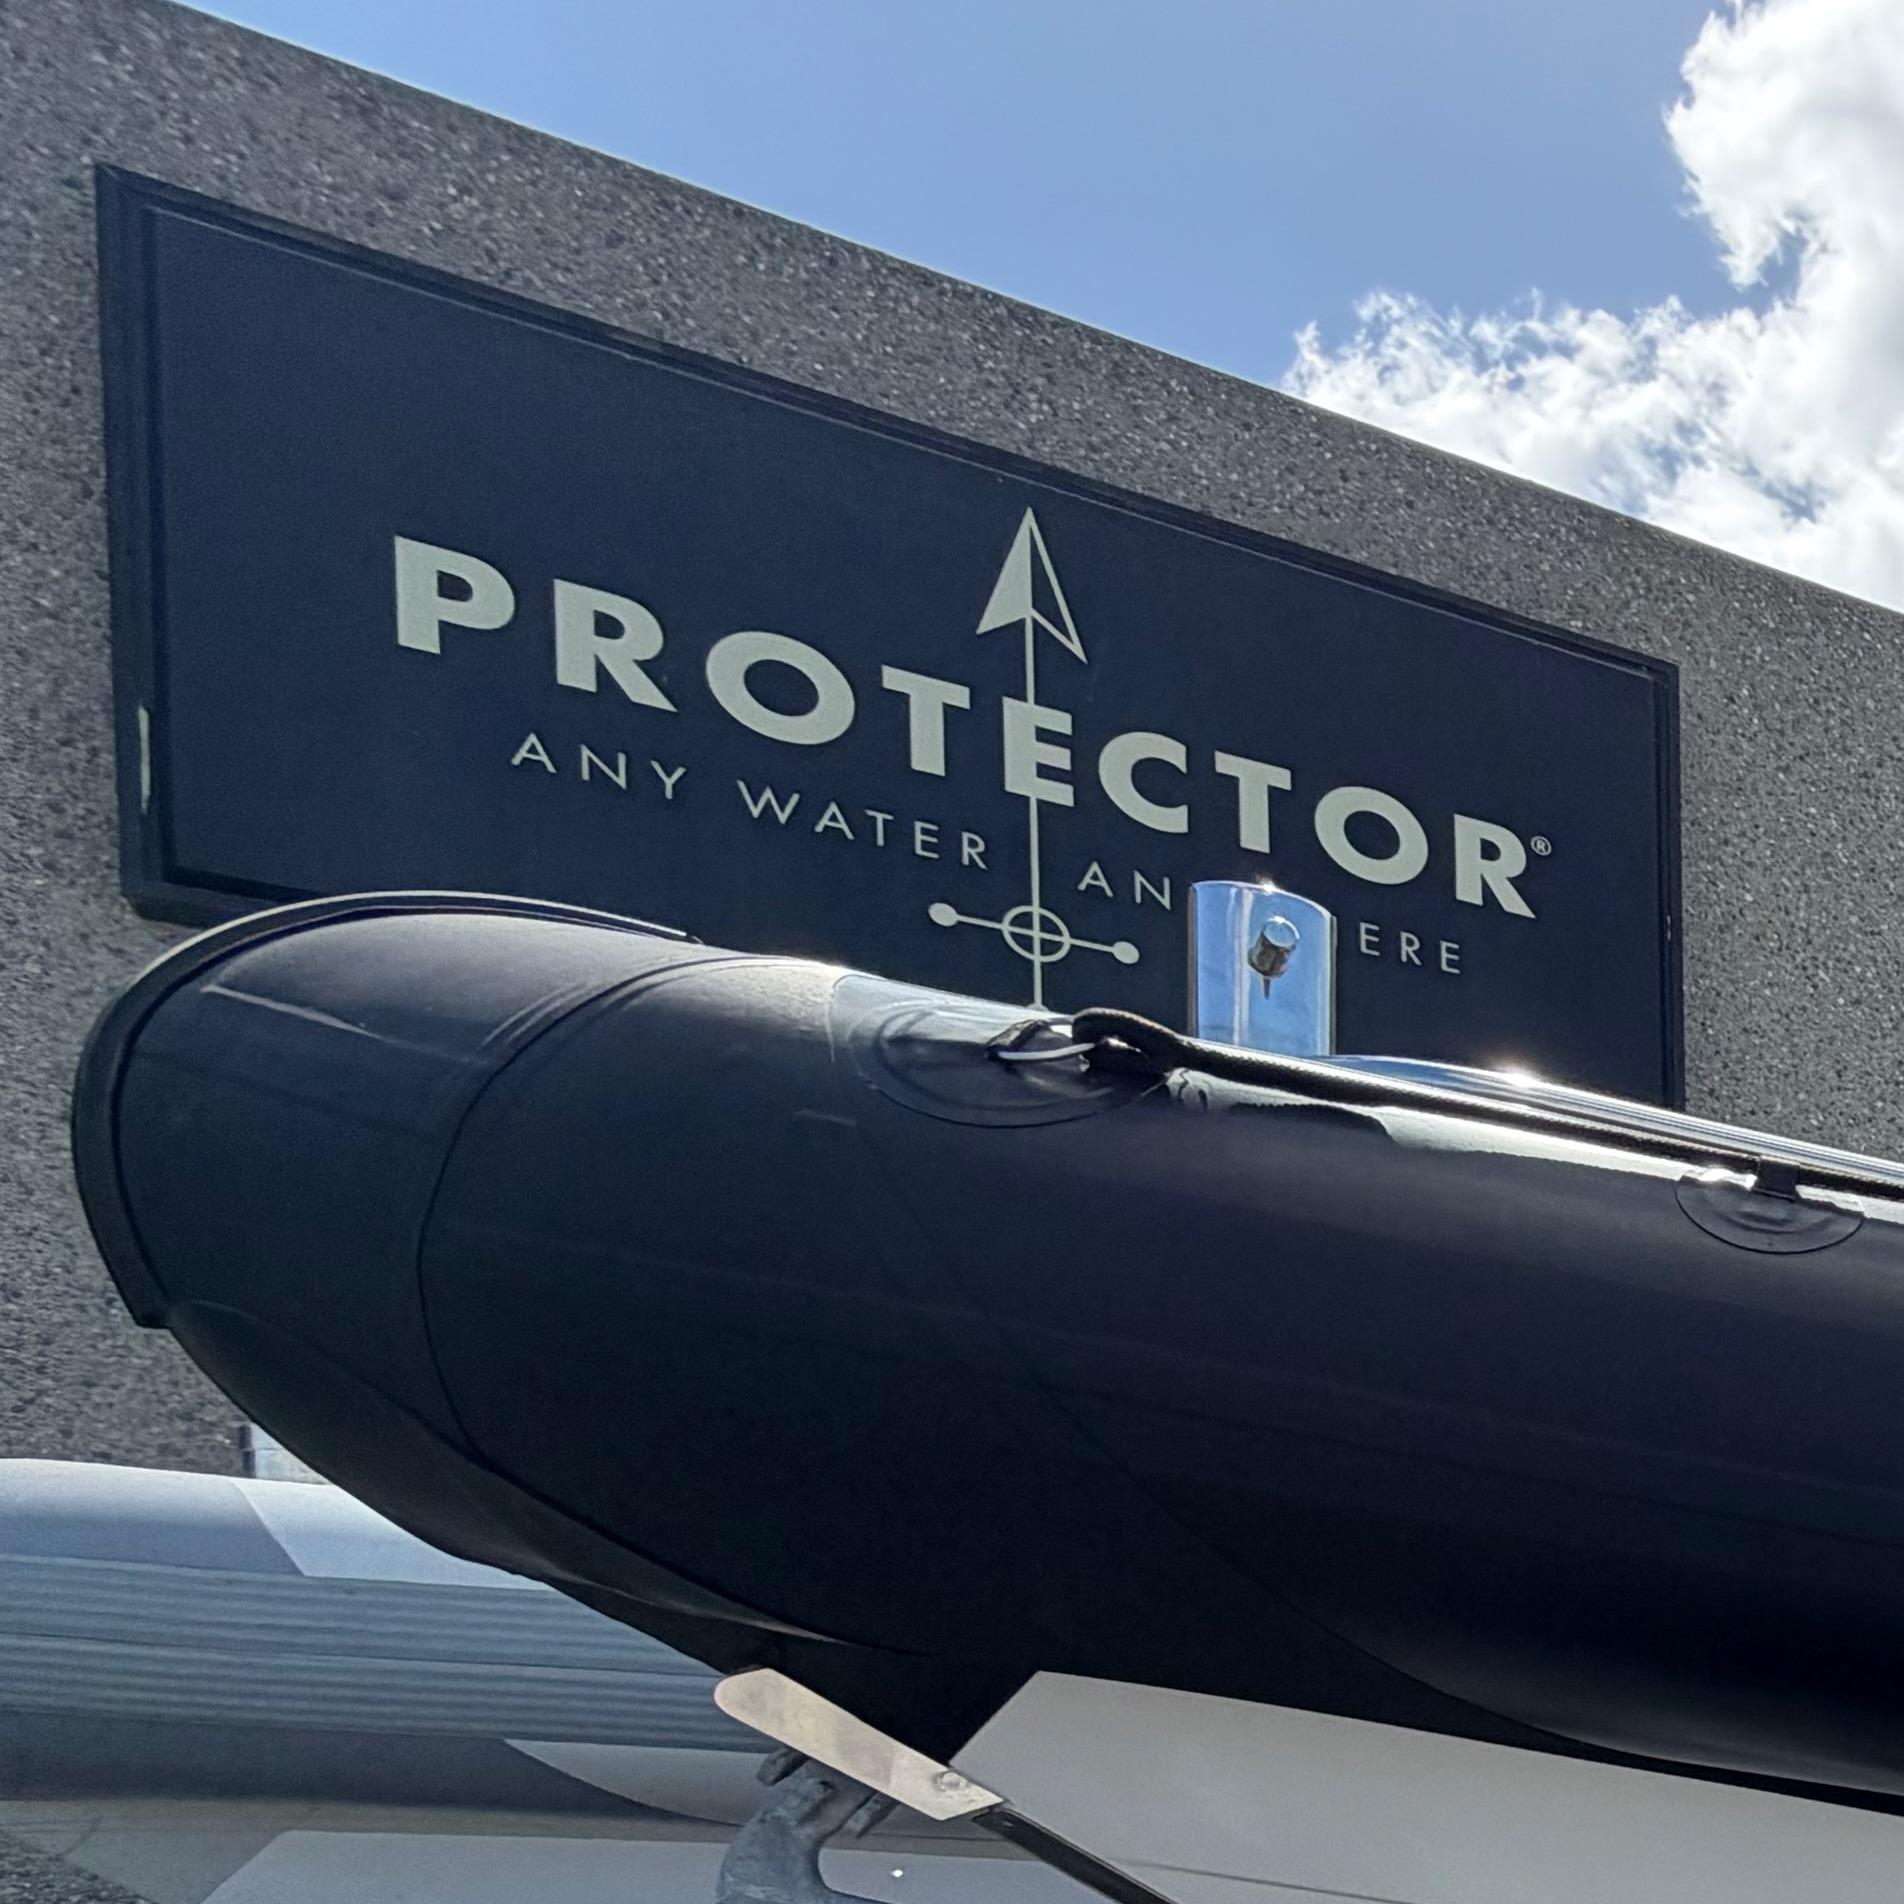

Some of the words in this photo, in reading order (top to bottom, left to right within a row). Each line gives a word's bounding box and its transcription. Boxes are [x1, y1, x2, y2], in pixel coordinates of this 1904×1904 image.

[511, 733, 686, 800] ANY
[736, 779, 988, 870] WATER
[1078, 861, 1461, 974] ANERE
